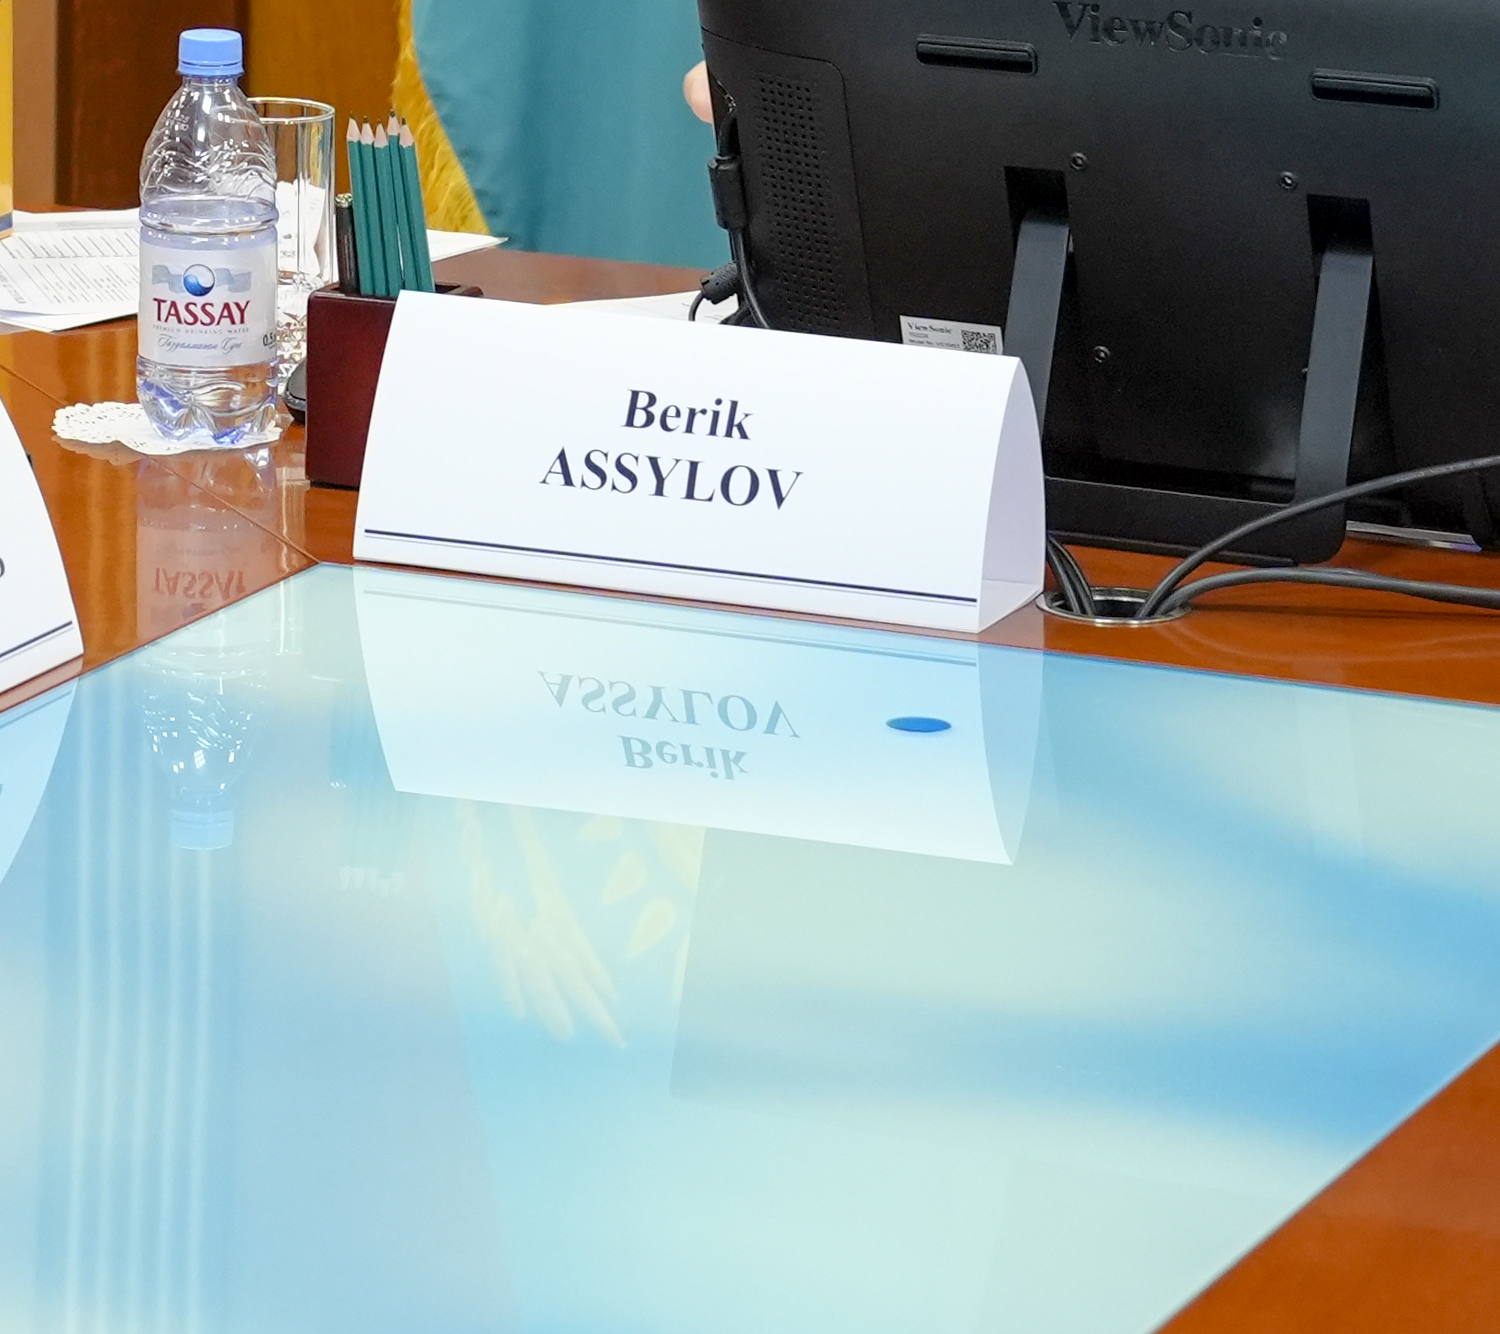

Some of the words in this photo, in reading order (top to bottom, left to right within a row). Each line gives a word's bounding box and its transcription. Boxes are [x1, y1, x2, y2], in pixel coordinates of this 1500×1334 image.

[1052, 0, 1288, 61] ViewSonic
[152, 297, 251, 327] TASSAY
[620, 388, 754, 441] Berik
[539, 445, 805, 511] ASSYLOV
